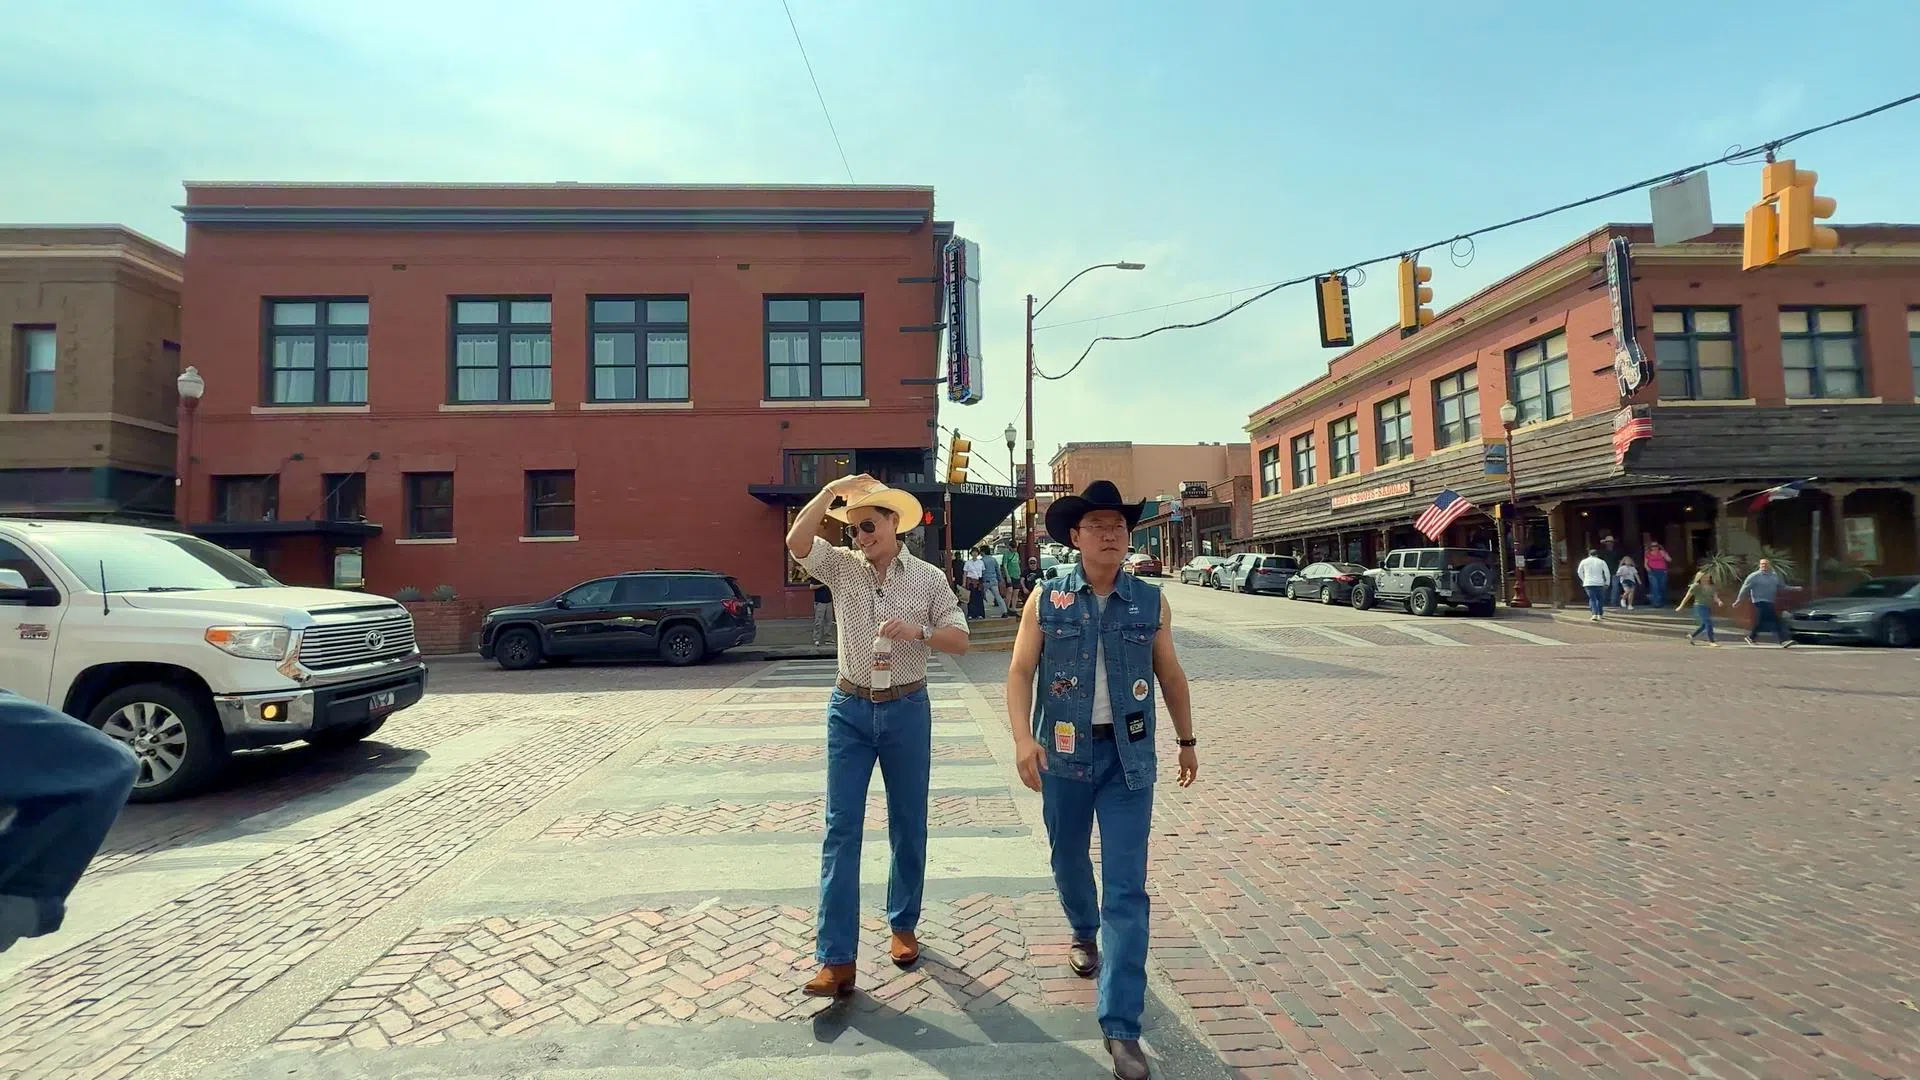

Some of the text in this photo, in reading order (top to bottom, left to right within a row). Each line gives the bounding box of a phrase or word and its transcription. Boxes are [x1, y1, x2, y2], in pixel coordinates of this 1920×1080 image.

[949, 251, 959, 384] GENERAL STORE
[960, 483, 1017, 498] GENERAL STORE
